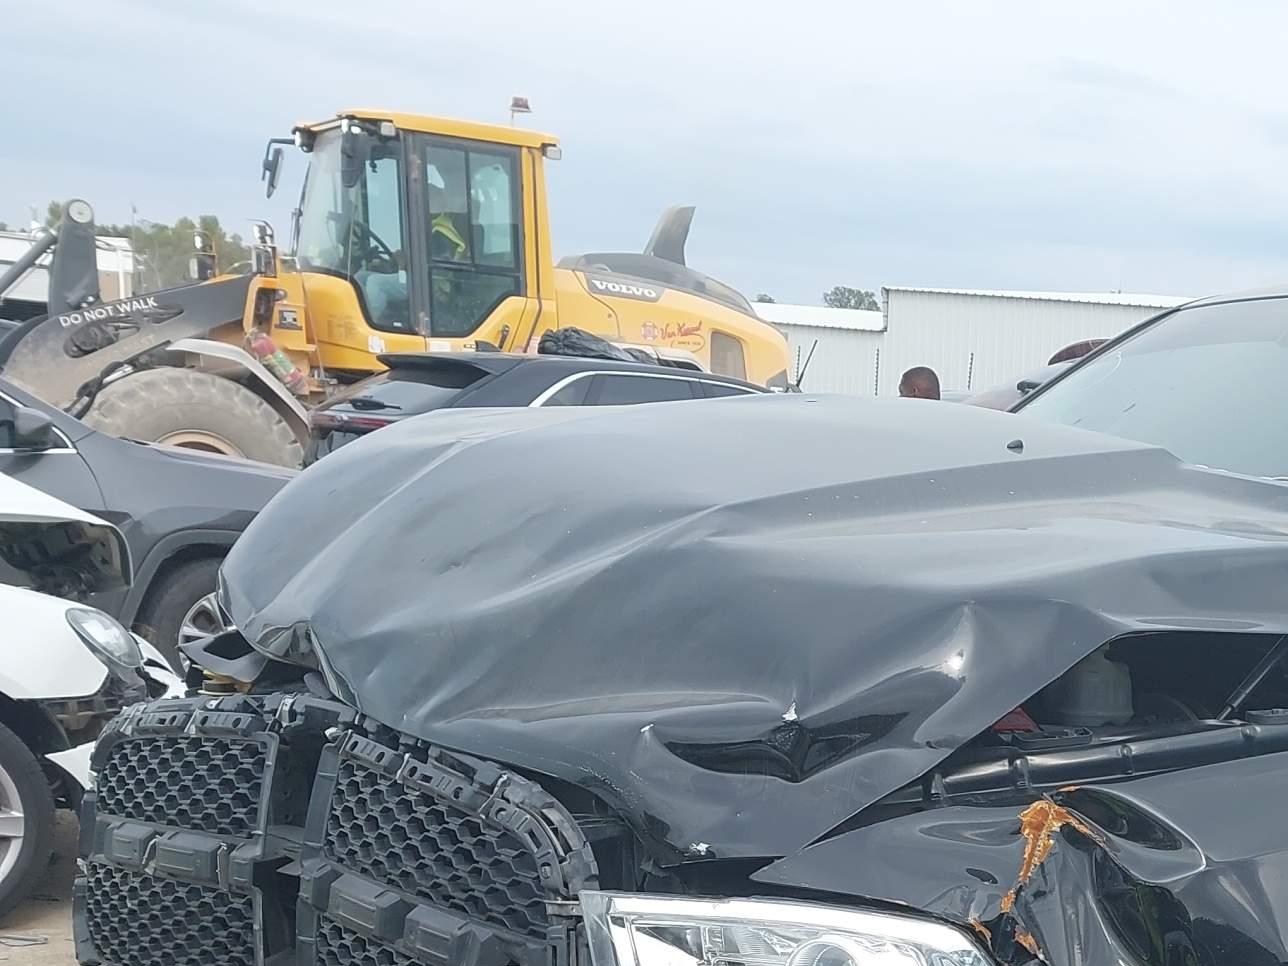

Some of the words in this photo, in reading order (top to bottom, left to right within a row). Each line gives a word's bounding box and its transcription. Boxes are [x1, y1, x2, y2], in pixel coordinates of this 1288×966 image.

[592, 279, 657, 298] VOLVO
[59, 314, 82, 327] DO
[84, 305, 115, 322] NOT
[116, 296, 158, 313] WALK
